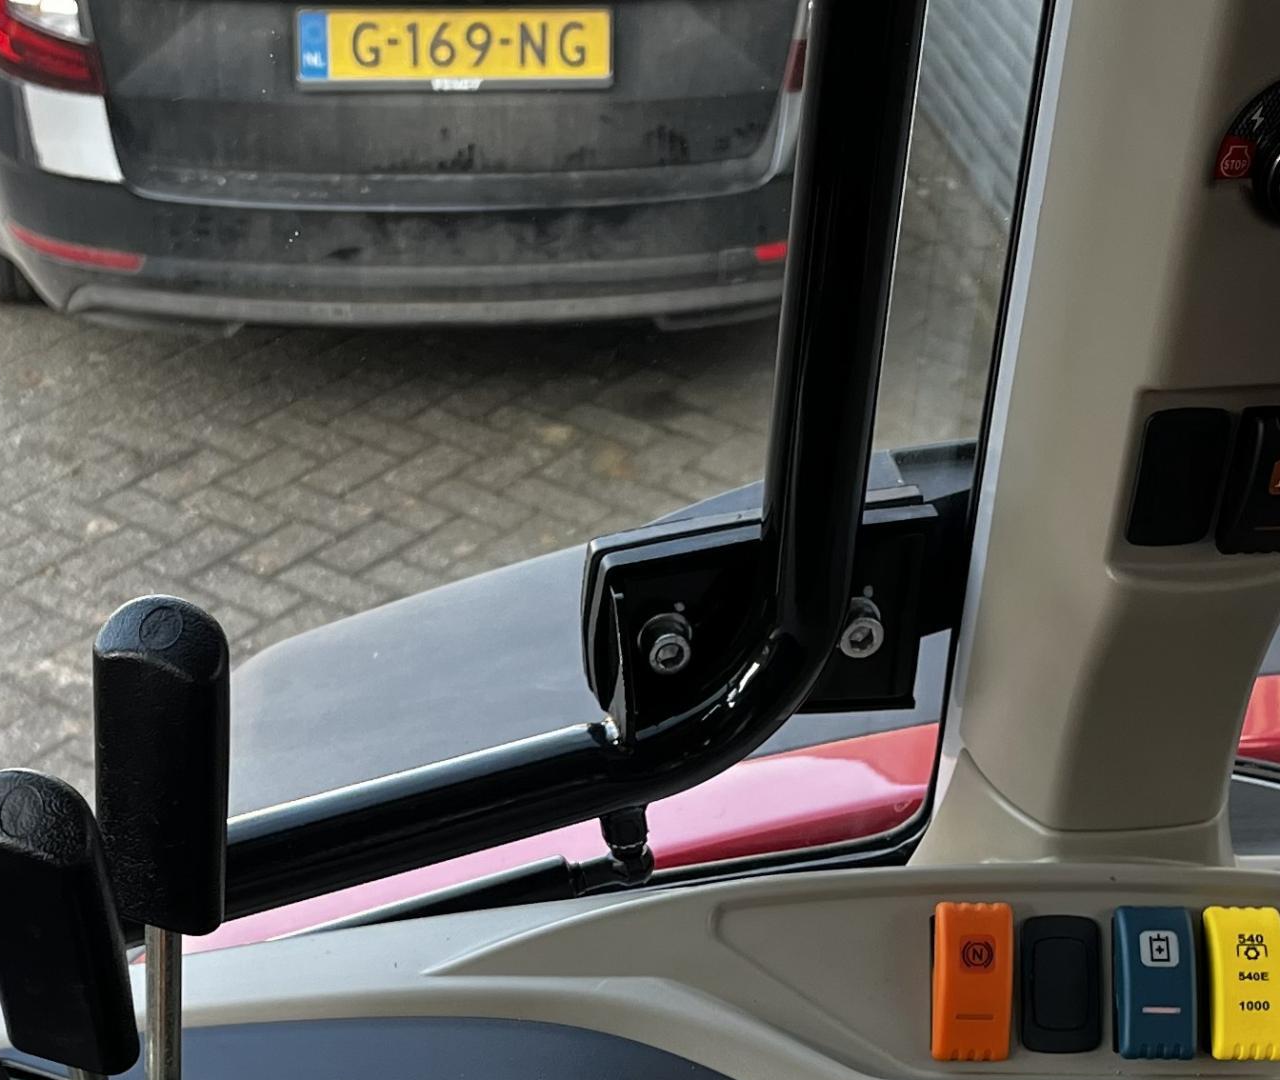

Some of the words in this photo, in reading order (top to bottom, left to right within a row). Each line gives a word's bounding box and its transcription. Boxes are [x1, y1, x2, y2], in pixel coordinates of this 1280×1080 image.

[351, 21, 587, 68] G-169-NG
[1223, 159, 1248, 170] STOP
[1237, 933, 1264, 944] 540
[972, 947, 984, 961] N
[1238, 971, 1270, 981] 540E
[1238, 1000, 1271, 1012] 1000
